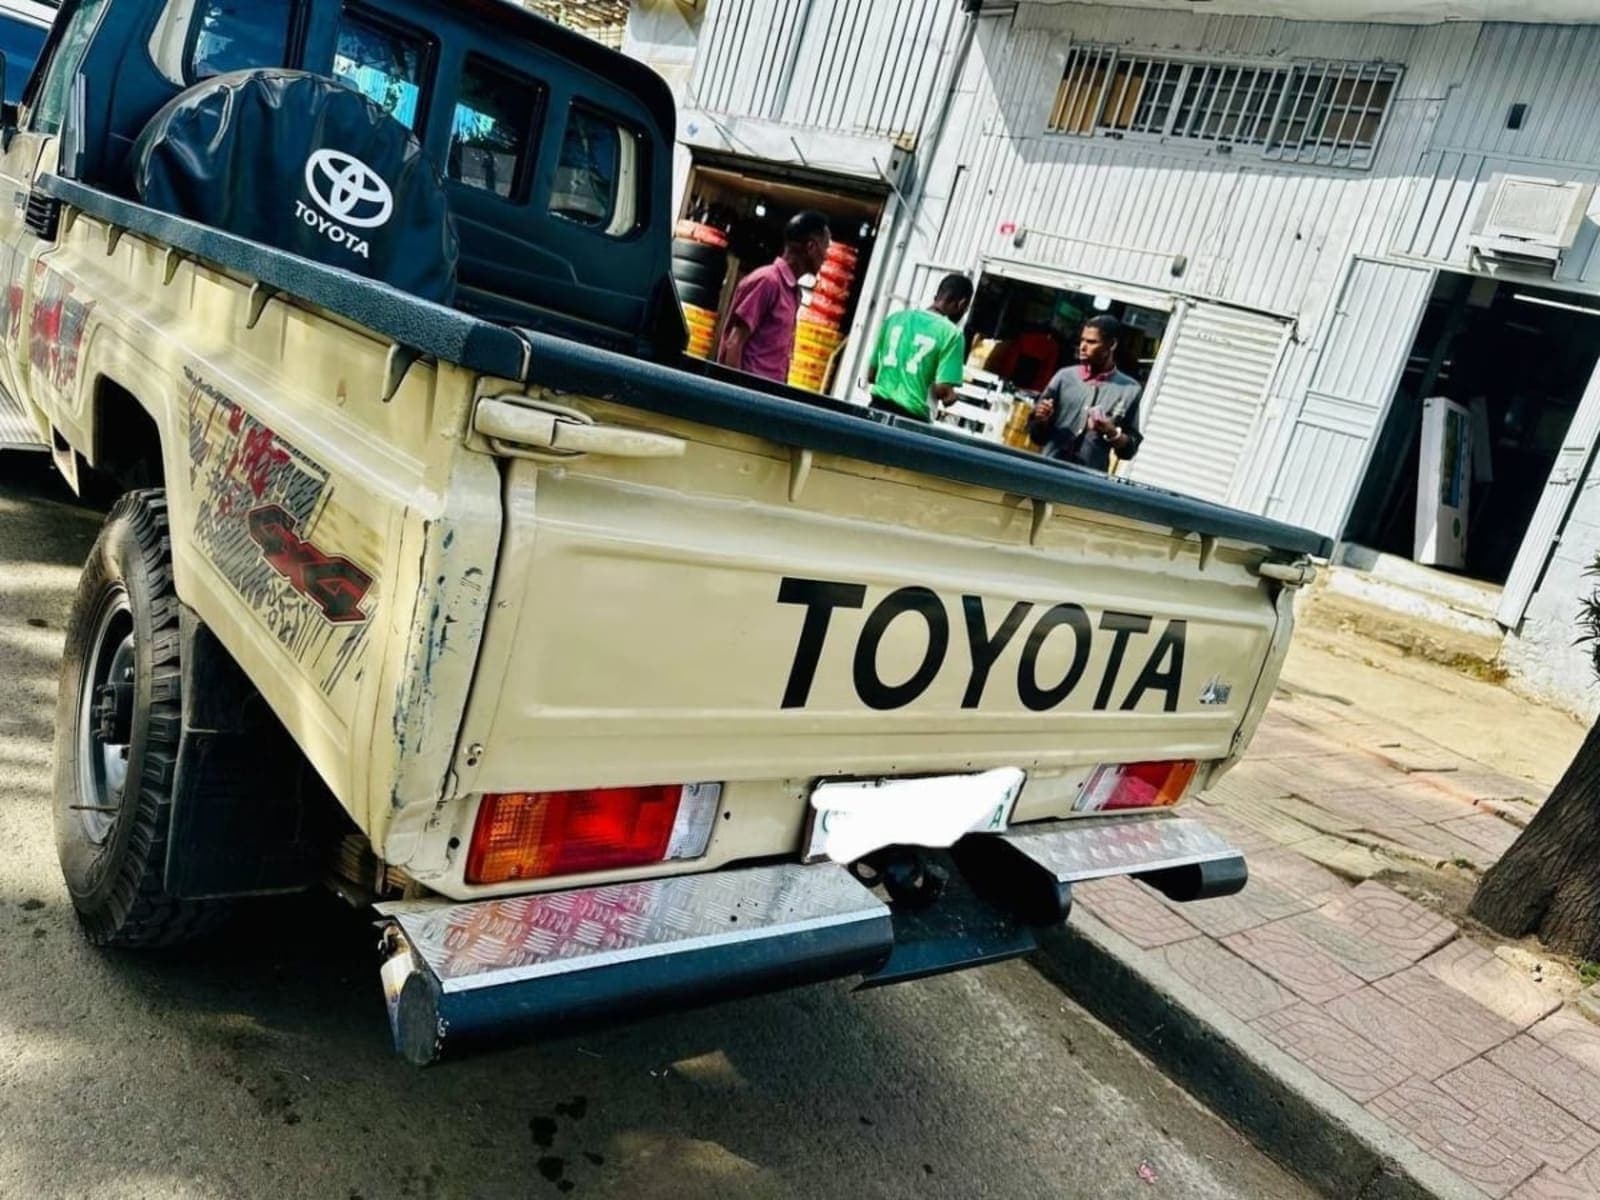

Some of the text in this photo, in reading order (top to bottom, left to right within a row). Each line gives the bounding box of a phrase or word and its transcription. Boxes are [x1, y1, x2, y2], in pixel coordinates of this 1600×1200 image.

[295, 199, 369, 258] TOYOTA
[883, 325, 937, 375] 17
[777, 576, 1187, 712] TOYOTA
